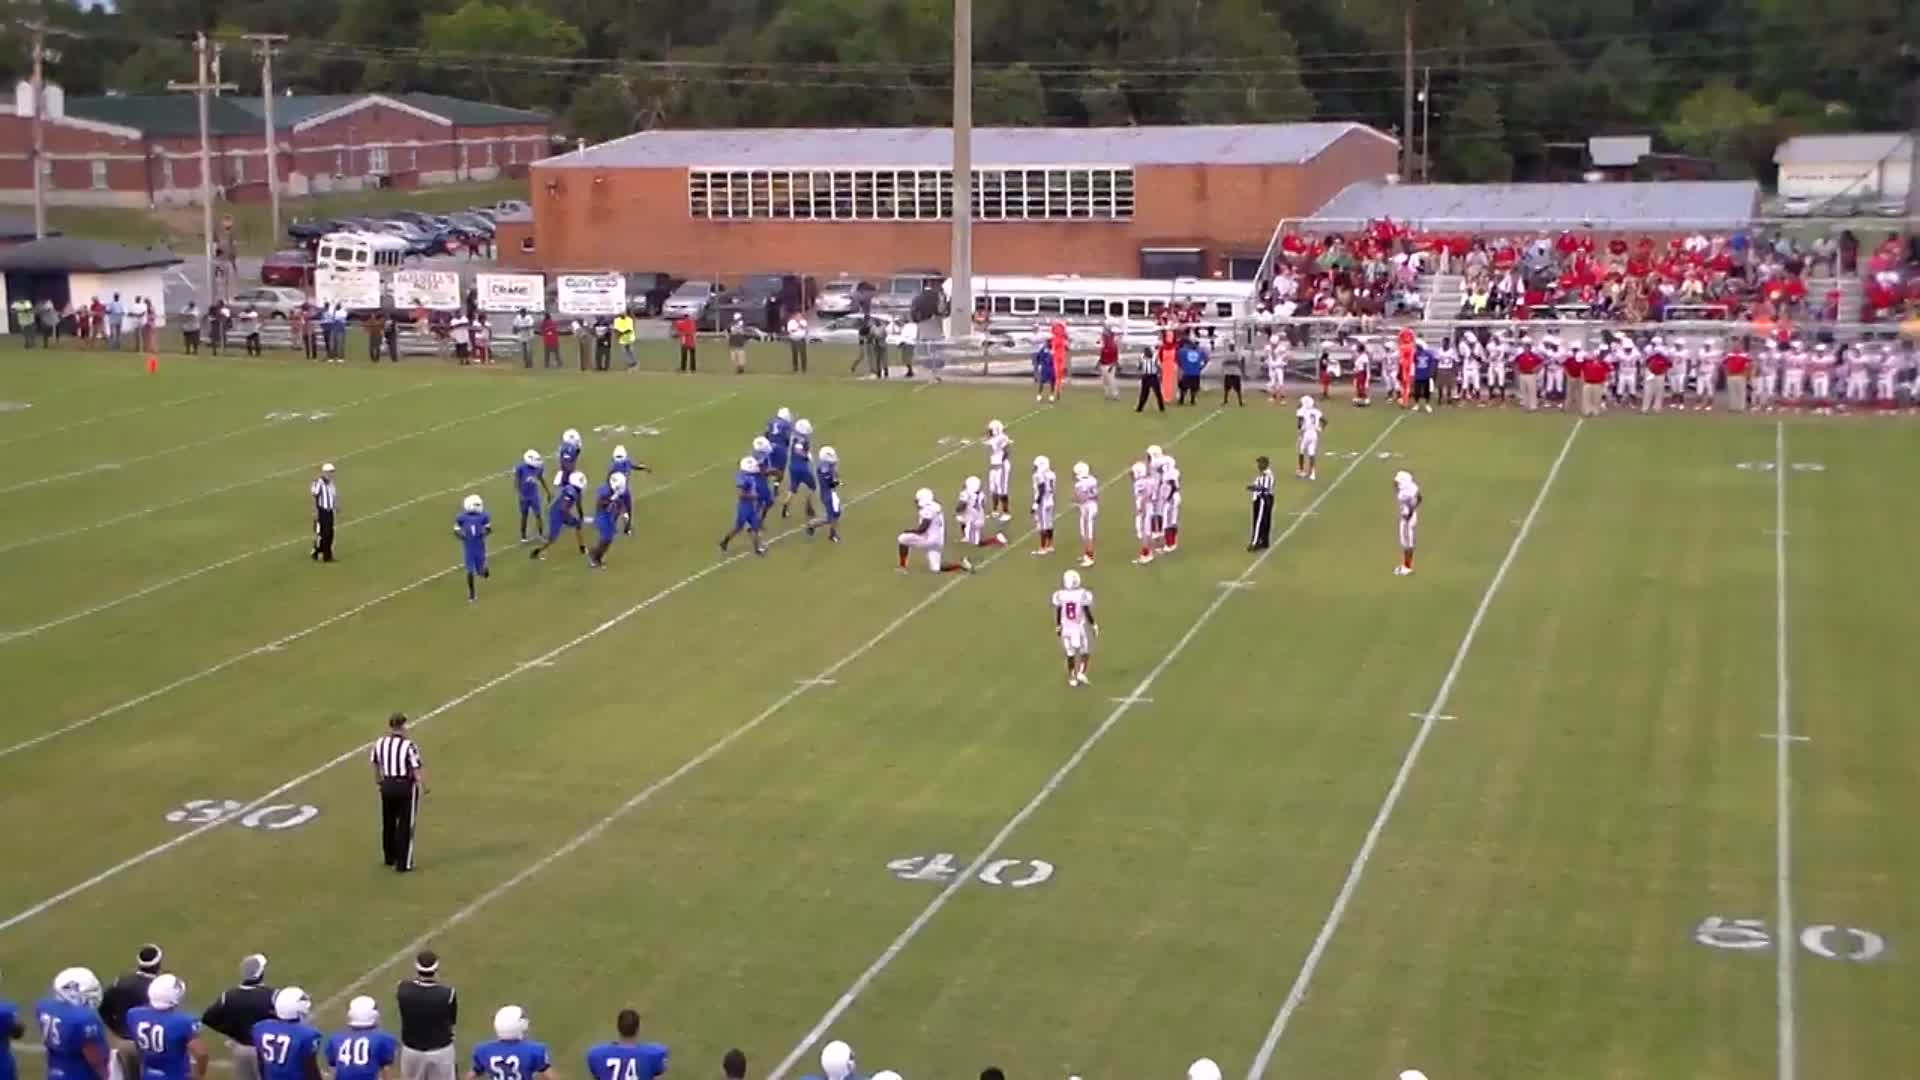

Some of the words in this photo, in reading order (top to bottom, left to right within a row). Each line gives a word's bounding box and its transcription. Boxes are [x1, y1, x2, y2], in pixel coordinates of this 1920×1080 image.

[1696, 916, 1885, 961] 50
[136, 1020, 166, 1054] 50
[261, 1032, 291, 1065] 57
[337, 1036, 370, 1067] 40
[489, 1055, 523, 1080] 53
[605, 1057, 640, 1080] 74
